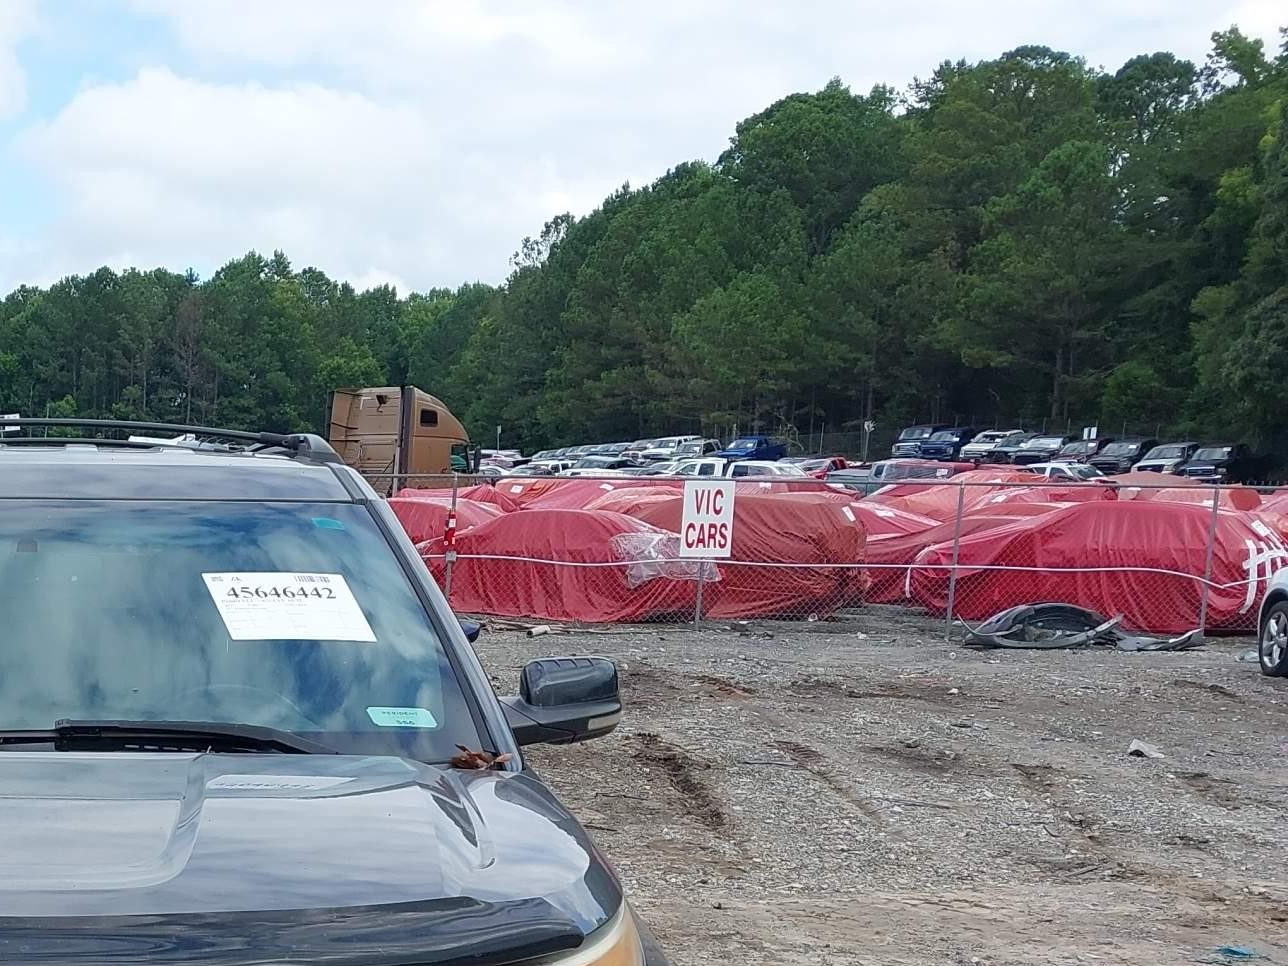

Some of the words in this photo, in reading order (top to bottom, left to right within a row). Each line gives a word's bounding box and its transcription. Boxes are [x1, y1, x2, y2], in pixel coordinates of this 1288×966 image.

[695, 488, 724, 516] VIC
[685, 522, 728, 549] CARS
[227, 586, 337, 599] 45646442
